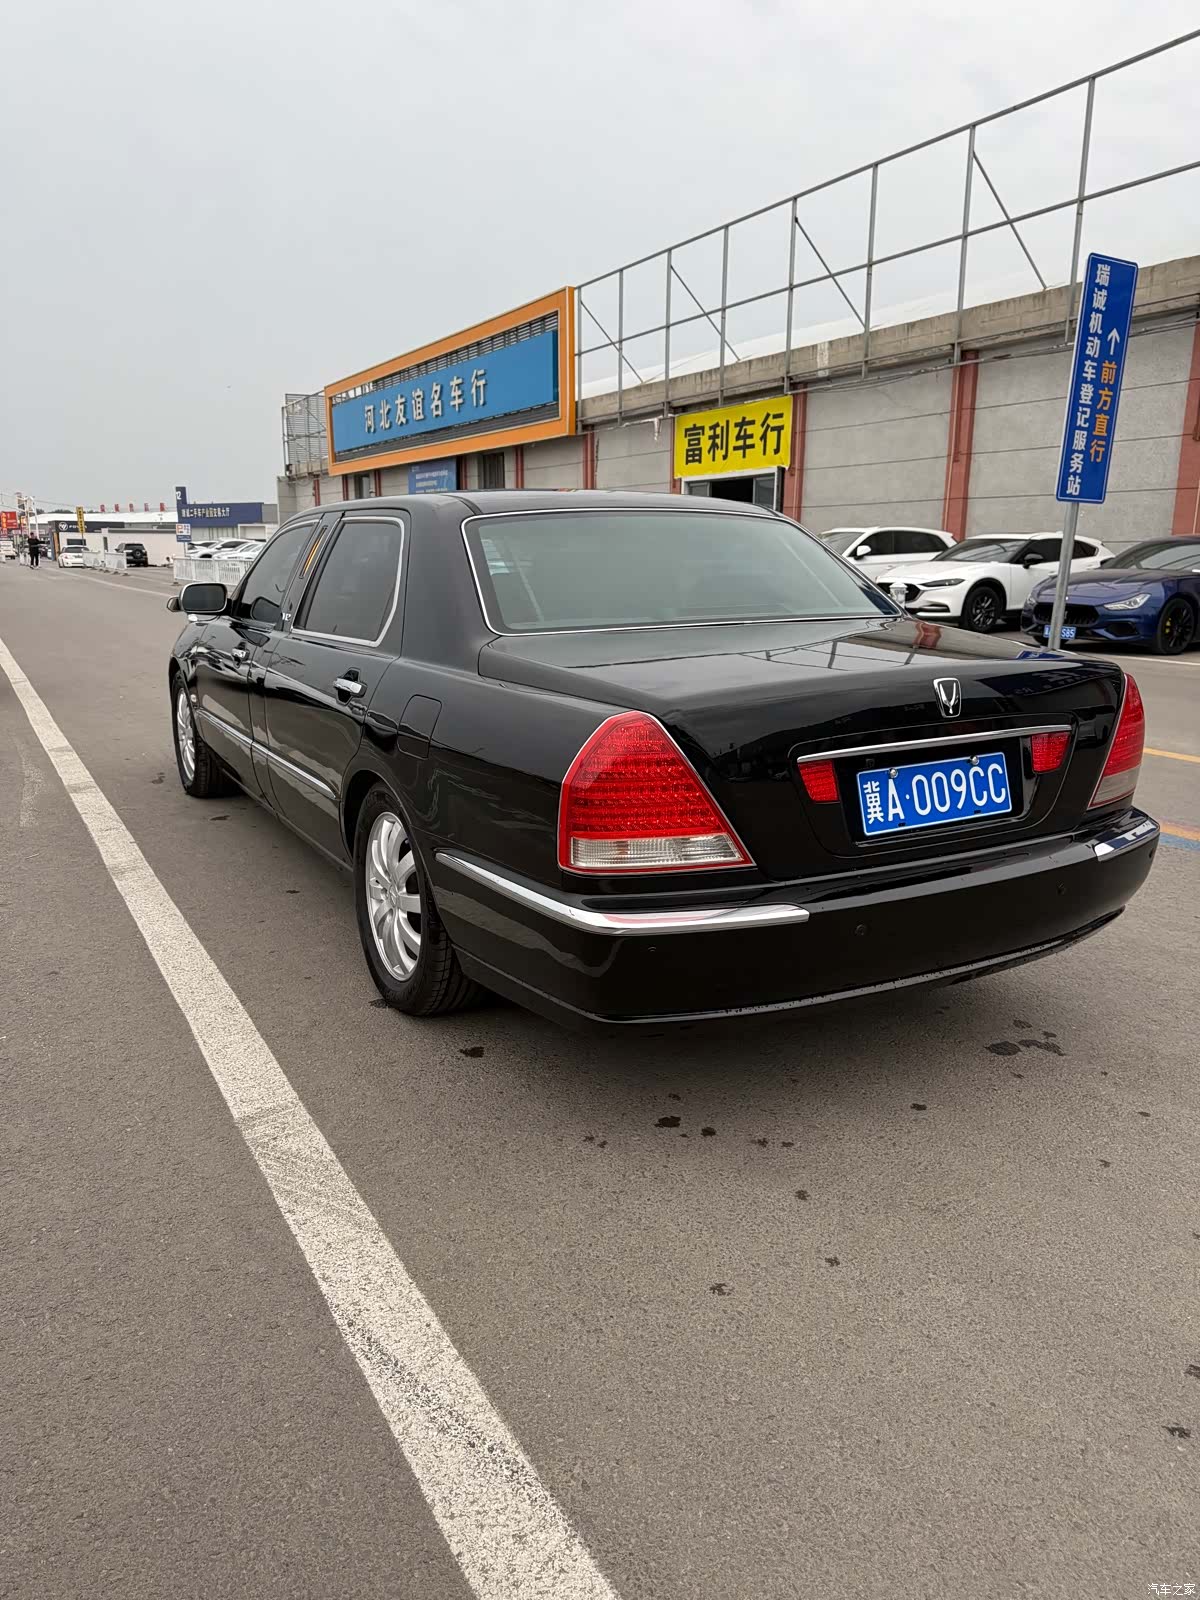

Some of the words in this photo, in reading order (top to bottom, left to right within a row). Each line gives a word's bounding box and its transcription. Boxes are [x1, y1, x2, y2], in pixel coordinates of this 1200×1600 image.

[363, 368, 488, 434] 河北友谊名车行
[1065, 263, 1112, 496] 瑞诚机动车登记服务站
[1089, 360, 1118, 463] 前方直行
[684, 411, 785, 466] 富利车行
